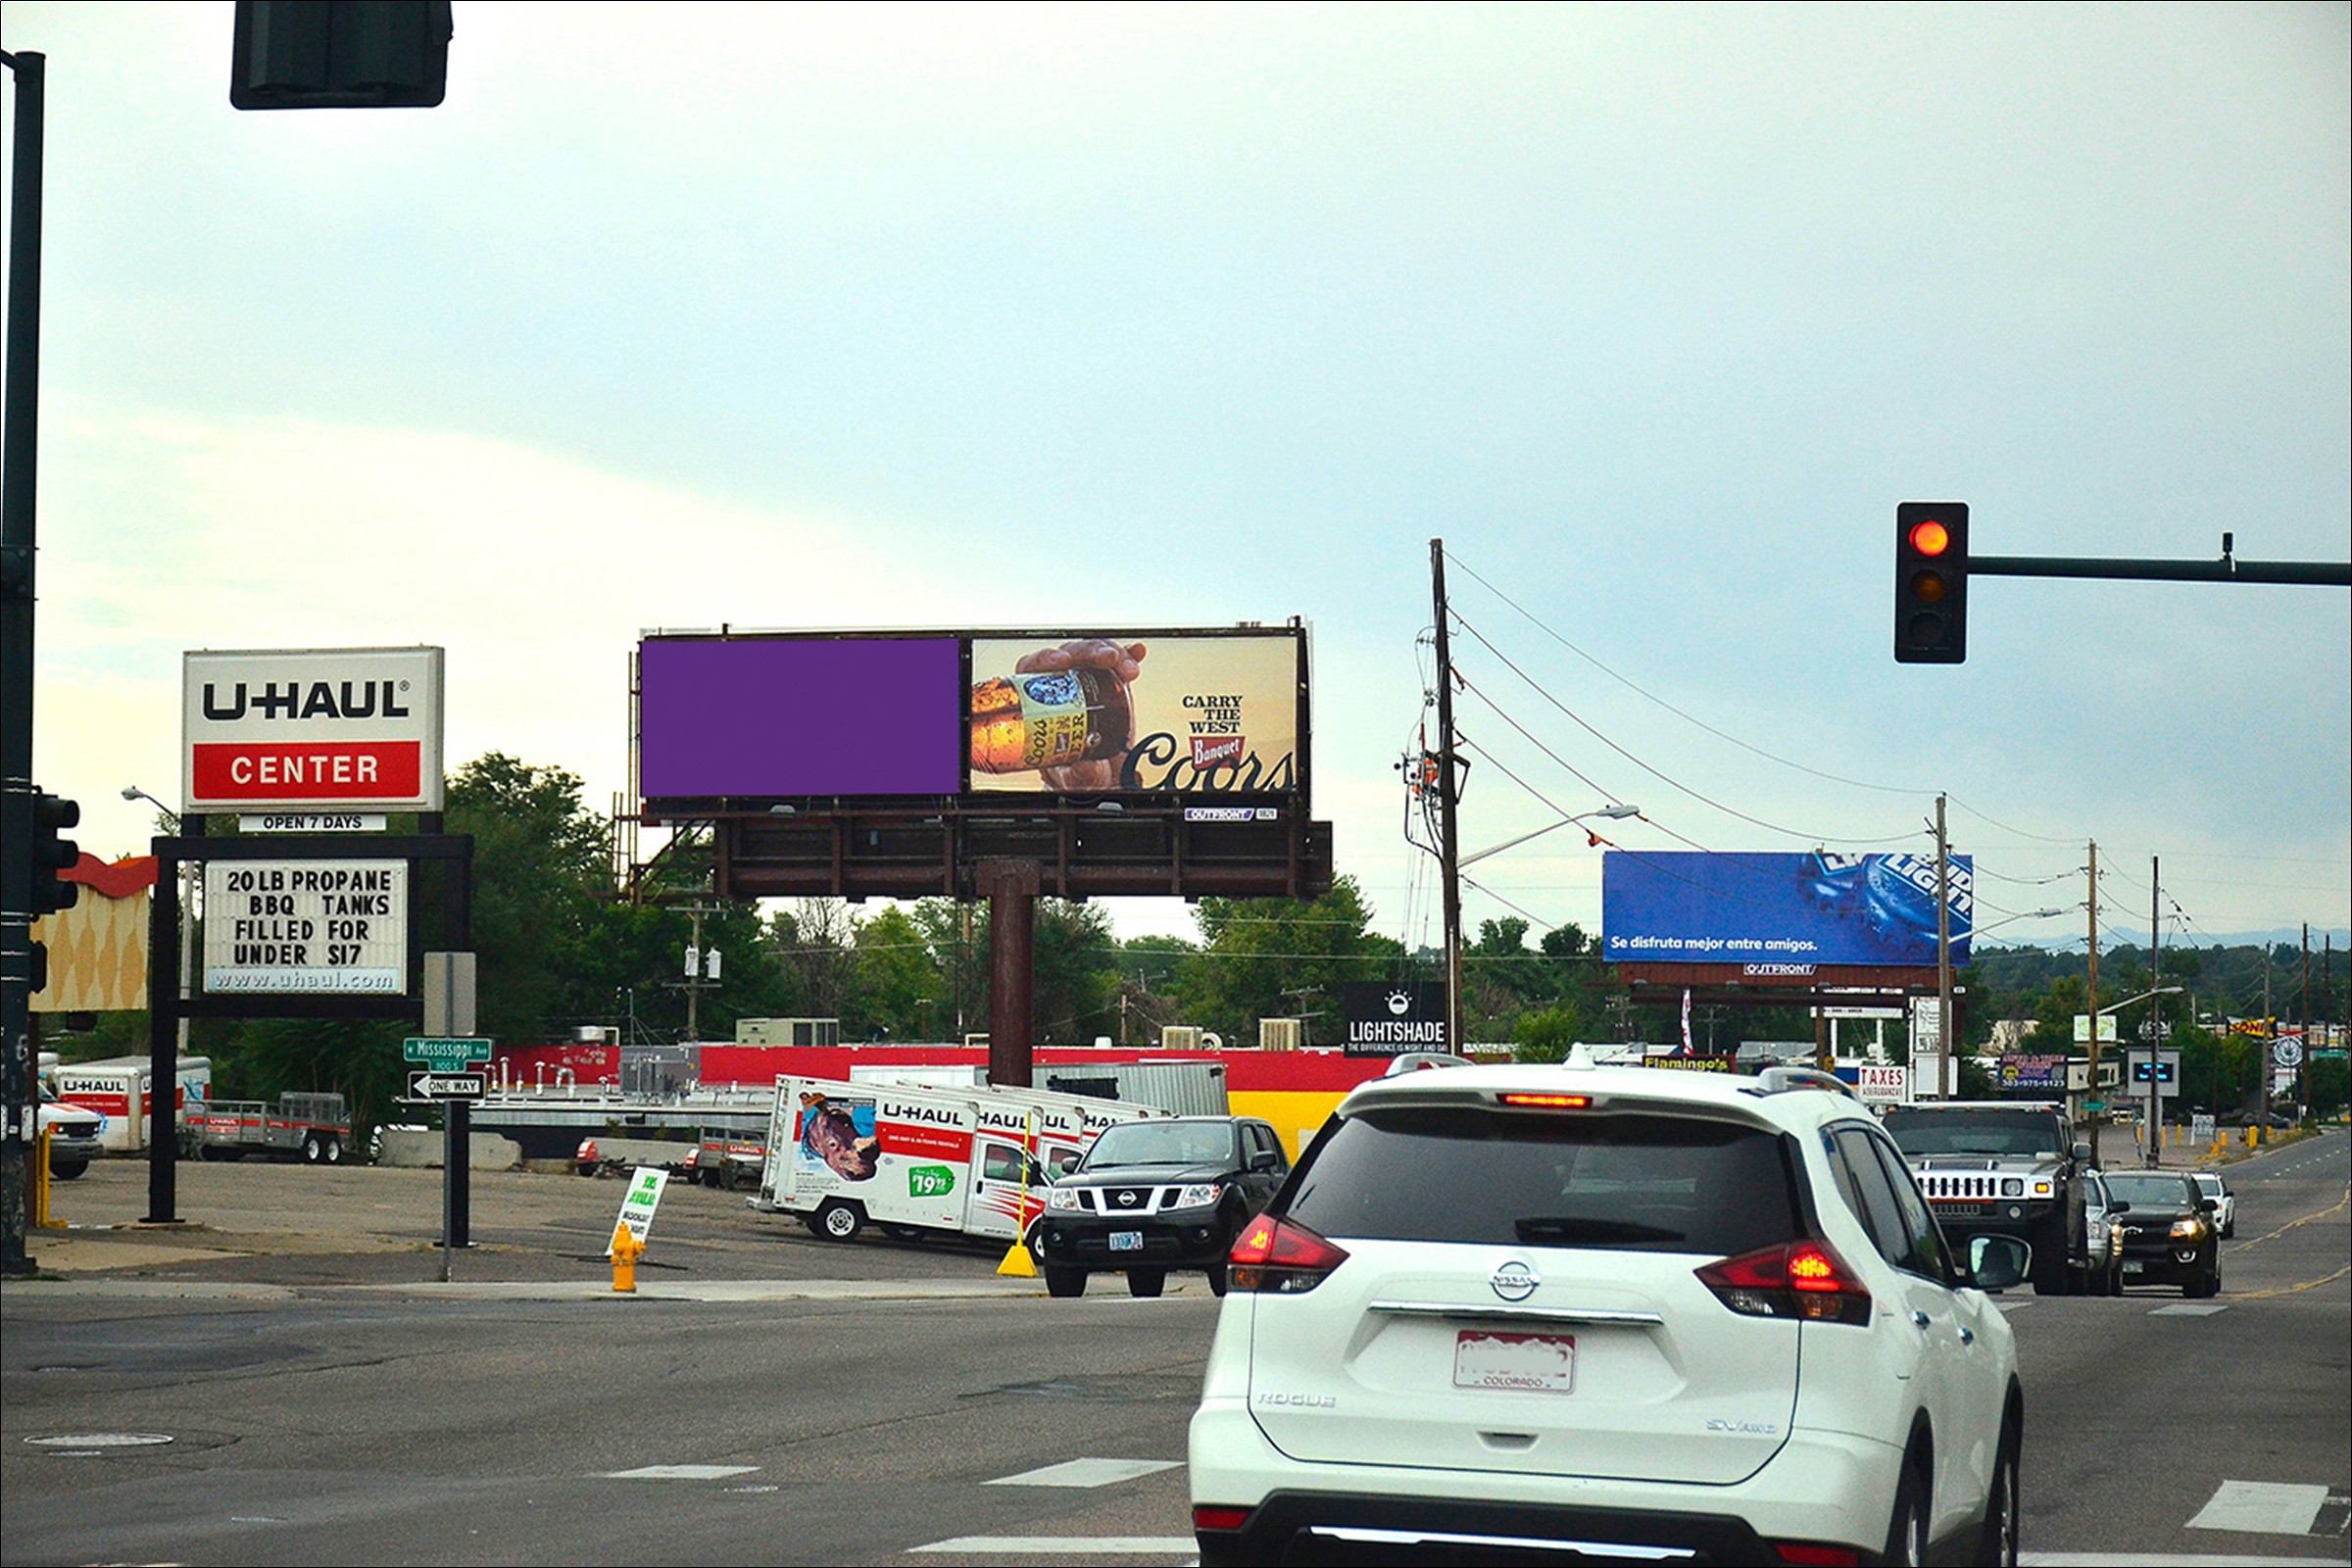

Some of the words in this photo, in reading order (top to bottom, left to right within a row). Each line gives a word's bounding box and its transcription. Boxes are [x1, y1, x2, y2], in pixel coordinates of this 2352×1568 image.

[203, 681, 410, 720] U-HAUL
[1182, 695, 1243, 709] CARRY
[1203, 709, 1241, 720] THE
[1189, 721, 1241, 734] WEST
[1194, 738, 1240, 764] Banquet
[230, 755, 378, 784] CENTER
[1119, 732, 1295, 792] Coors
[263, 816, 305, 830] OPEN
[310, 815, 318, 828] 7
[323, 815, 363, 829] DAYS
[291, 870, 391, 891] PROPANE
[250, 896, 295, 915] BBQ
[322, 895, 390, 915] TANKS
[235, 920, 314, 941] FILLED
[328, 920, 369, 941] FOR
[1611, 936, 1628, 949] Se
[1630, 936, 1683, 949] disfruta
[1685, 937, 1725, 952] mejor
[1727, 939, 1763, 950] entre
[1765, 938, 1818, 953] amigos.
[234, 945, 307, 965] UNDER
[1747, 964, 1812, 974] OUTFRONT
[216, 972, 393, 988] www.uhaul.com
[1350, 1021, 1445, 1042] LIGHTSHADE
[417, 1041, 472, 1059] Mississippi
[1645, 1057, 1728, 1070] Flamingo's
[1861, 1068, 1903, 1085] TAXES
[64, 1081, 124, 1092] U-HAUL
[428, 1081, 451, 1092] ONE
[454, 1081, 477, 1091] WAY
[883, 1103, 963, 1126] U-HAUL
[1493, 1275, 1535, 1284] NISSAN
[1483, 1376, 1544, 1388] COLORADO
[1257, 1393, 1336, 1408] ROGUE
